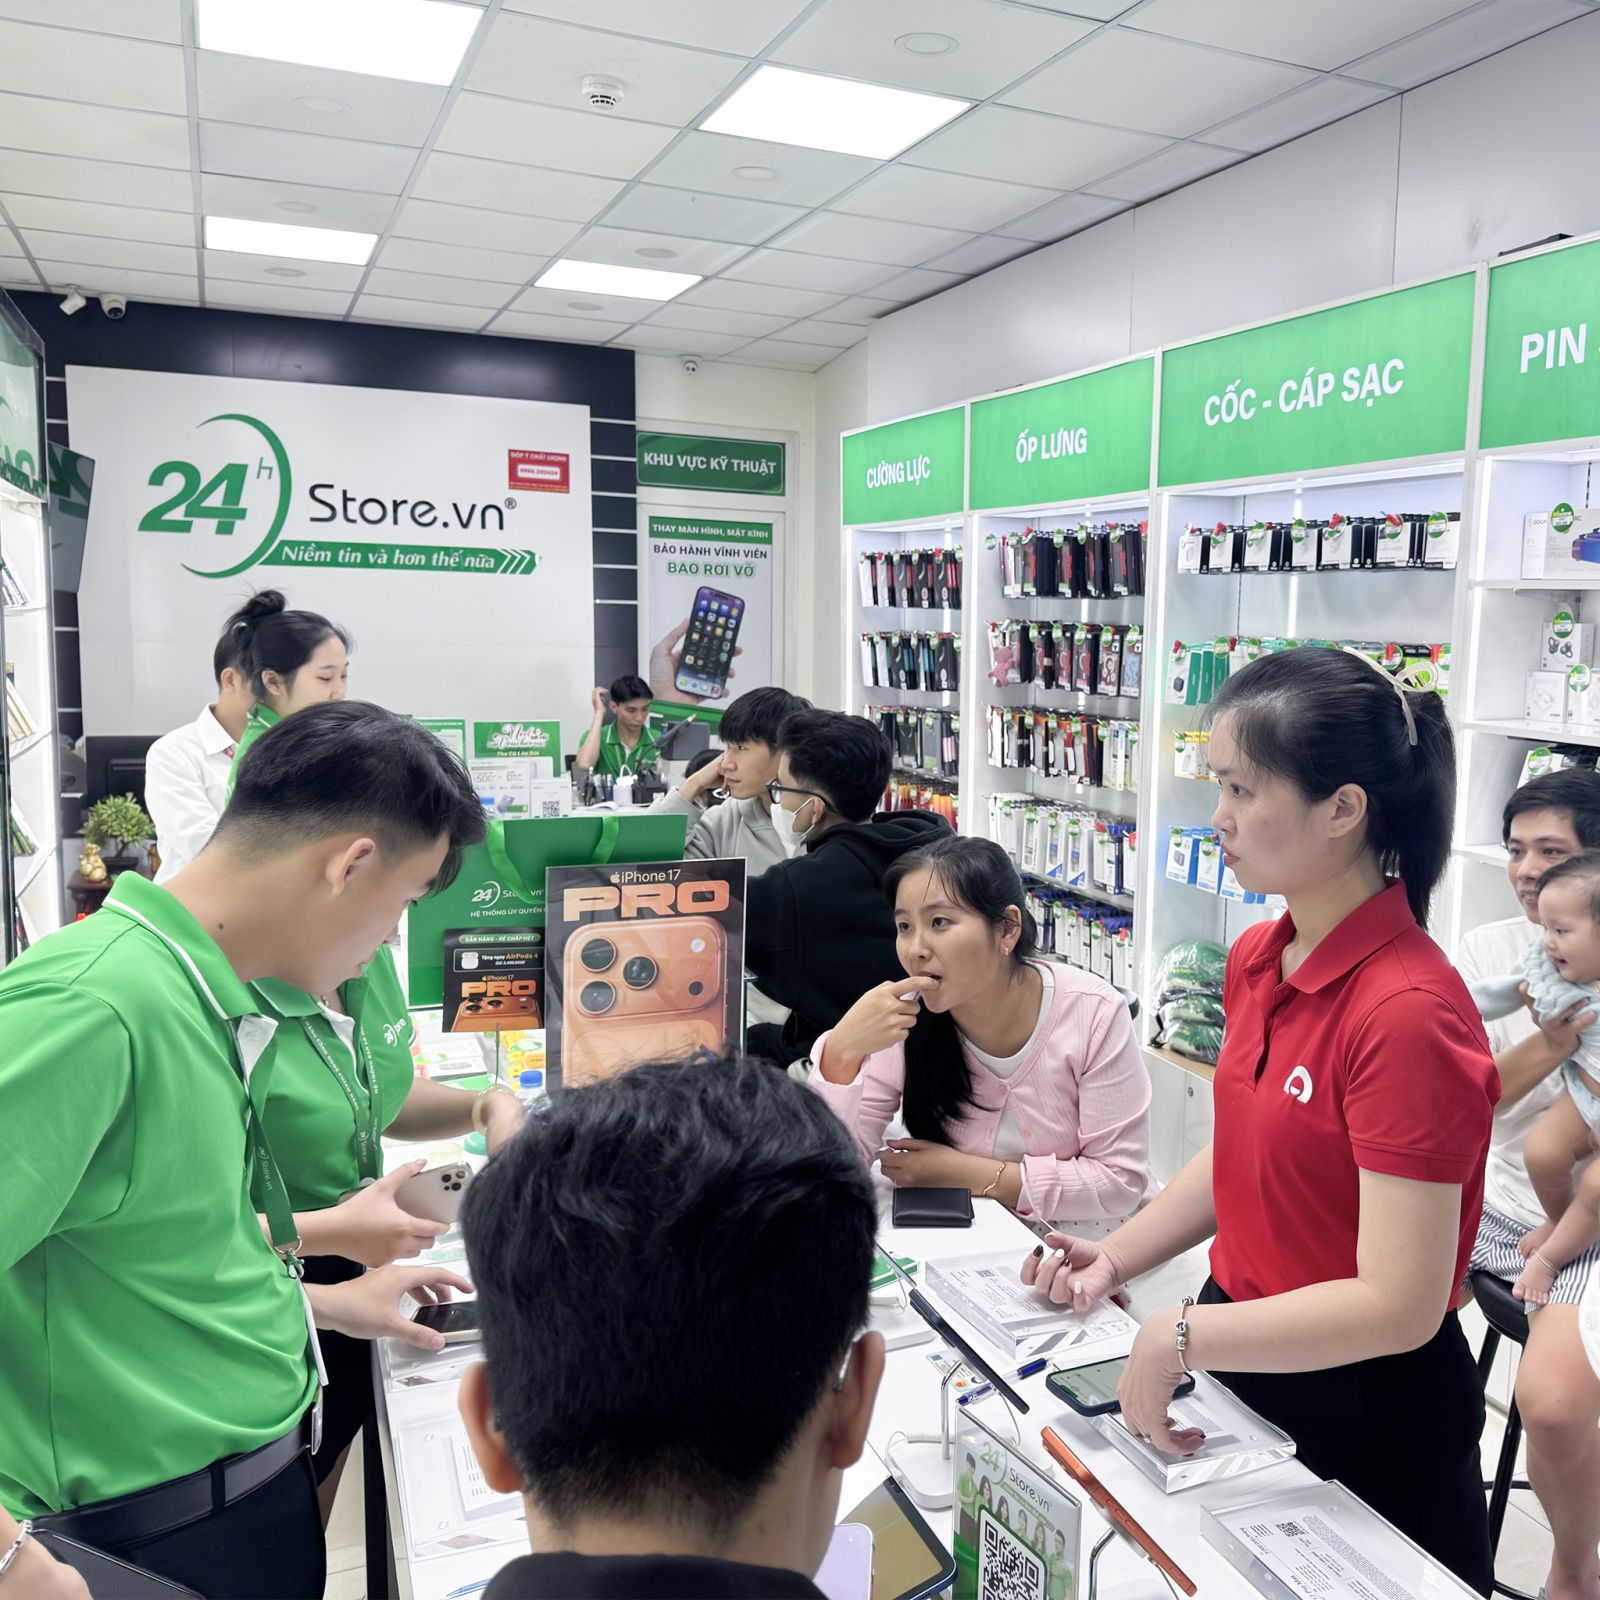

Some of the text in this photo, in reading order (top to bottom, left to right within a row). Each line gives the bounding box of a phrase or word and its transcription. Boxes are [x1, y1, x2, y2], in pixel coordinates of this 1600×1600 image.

[1520, 323, 1587, 374] PIN
[1204, 379, 1256, 426] CỐC
[1278, 366, 1334, 413] CÁP
[1342, 358, 1404, 407] SẠC
[1016, 427, 1087, 463] ỐP LƯNG
[643, 452, 777, 476] KHU VỰC KỸ THUẬT
[866, 454, 930, 488] CƯỜNG LỰC
[653, 524, 769, 538] THAY MÀN HÌNH, MẶT KÍNH
[281, 543, 496, 569] Niềm tin và hơn thế nữa
[653, 542, 677, 554] BẢO
[679, 544, 711, 556] HÀNH
[714, 545, 740, 558] VĨNH
[667, 562, 755, 577] BAO RƠI VỠ
[621, 869, 681, 883] iPhone 17
[471, 910, 480, 918] HỆ
[482, 908, 507, 916] THỐNG
[563, 880, 730, 922] PRO
[462, 980, 536, 998] PRO
[1008, 1467, 1051, 1513] Store.vn
